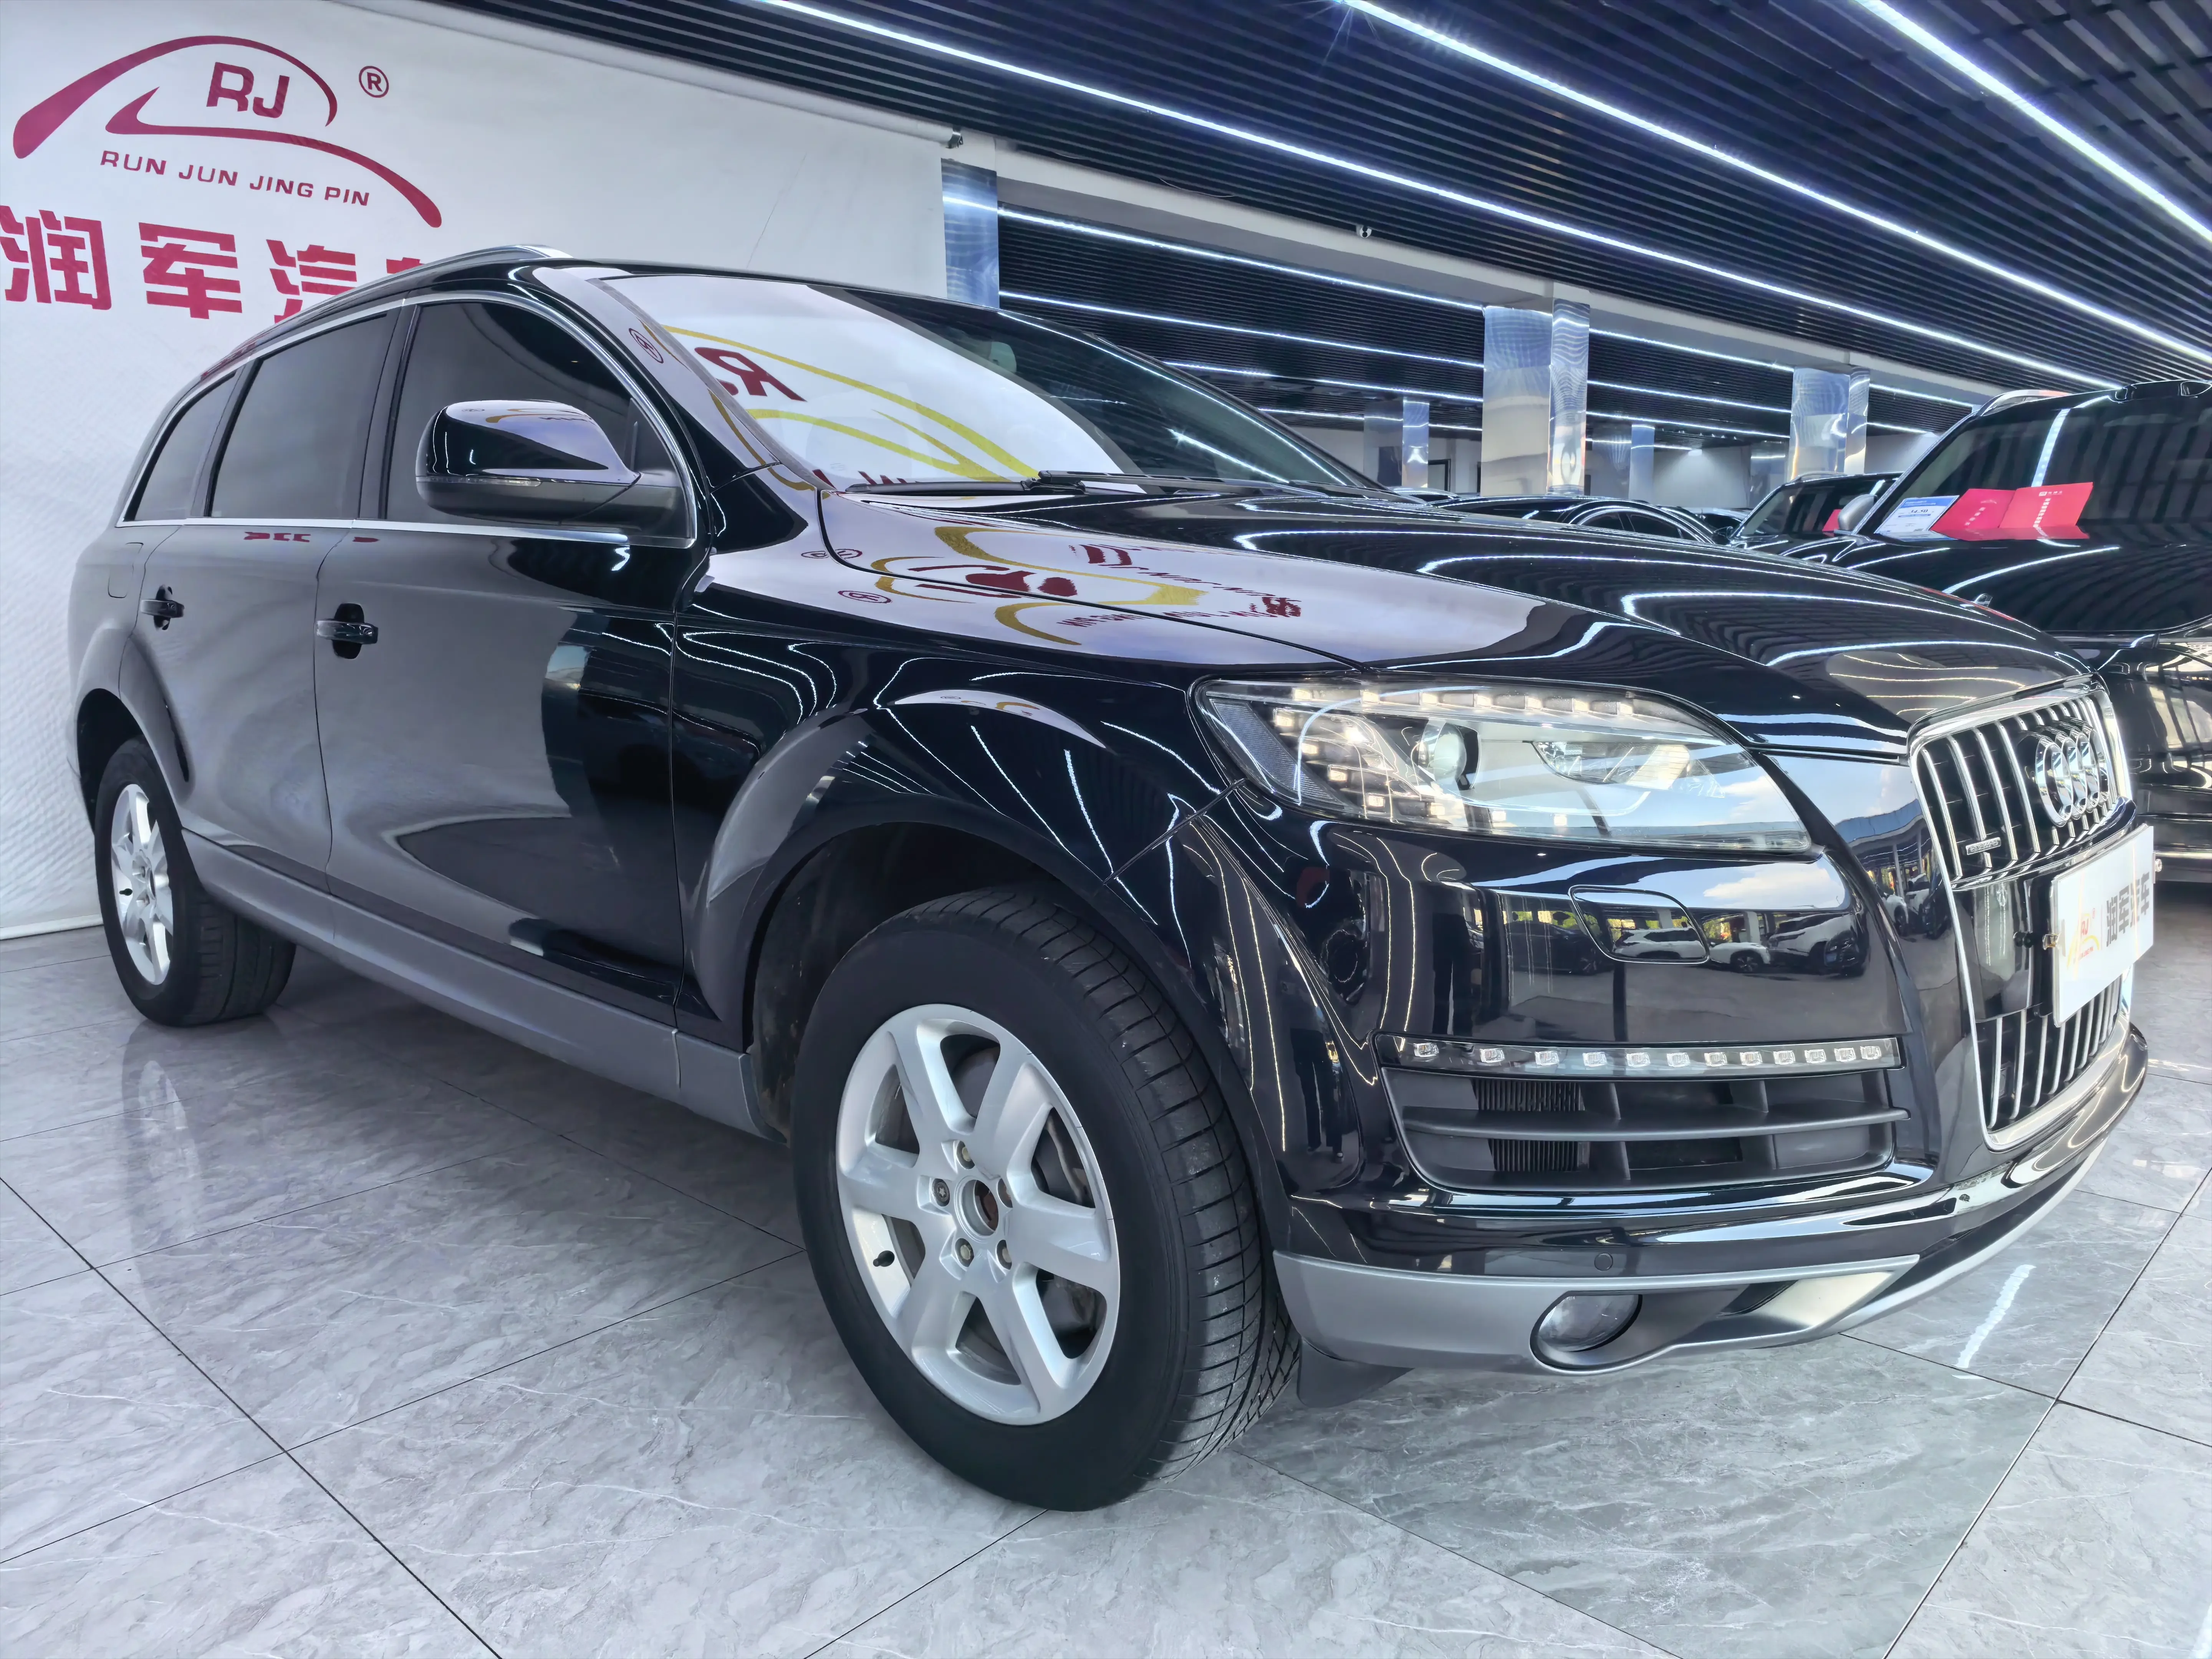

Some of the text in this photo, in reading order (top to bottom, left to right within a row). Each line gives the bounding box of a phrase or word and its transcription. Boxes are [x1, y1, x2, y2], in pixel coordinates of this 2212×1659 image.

[207, 62, 290, 118] RJ
[101, 151, 369, 206] RUN JUN JING PIN
[0, 205, 428, 323] 润军汽
[2106, 872, 2149, 947] 润军汽车
